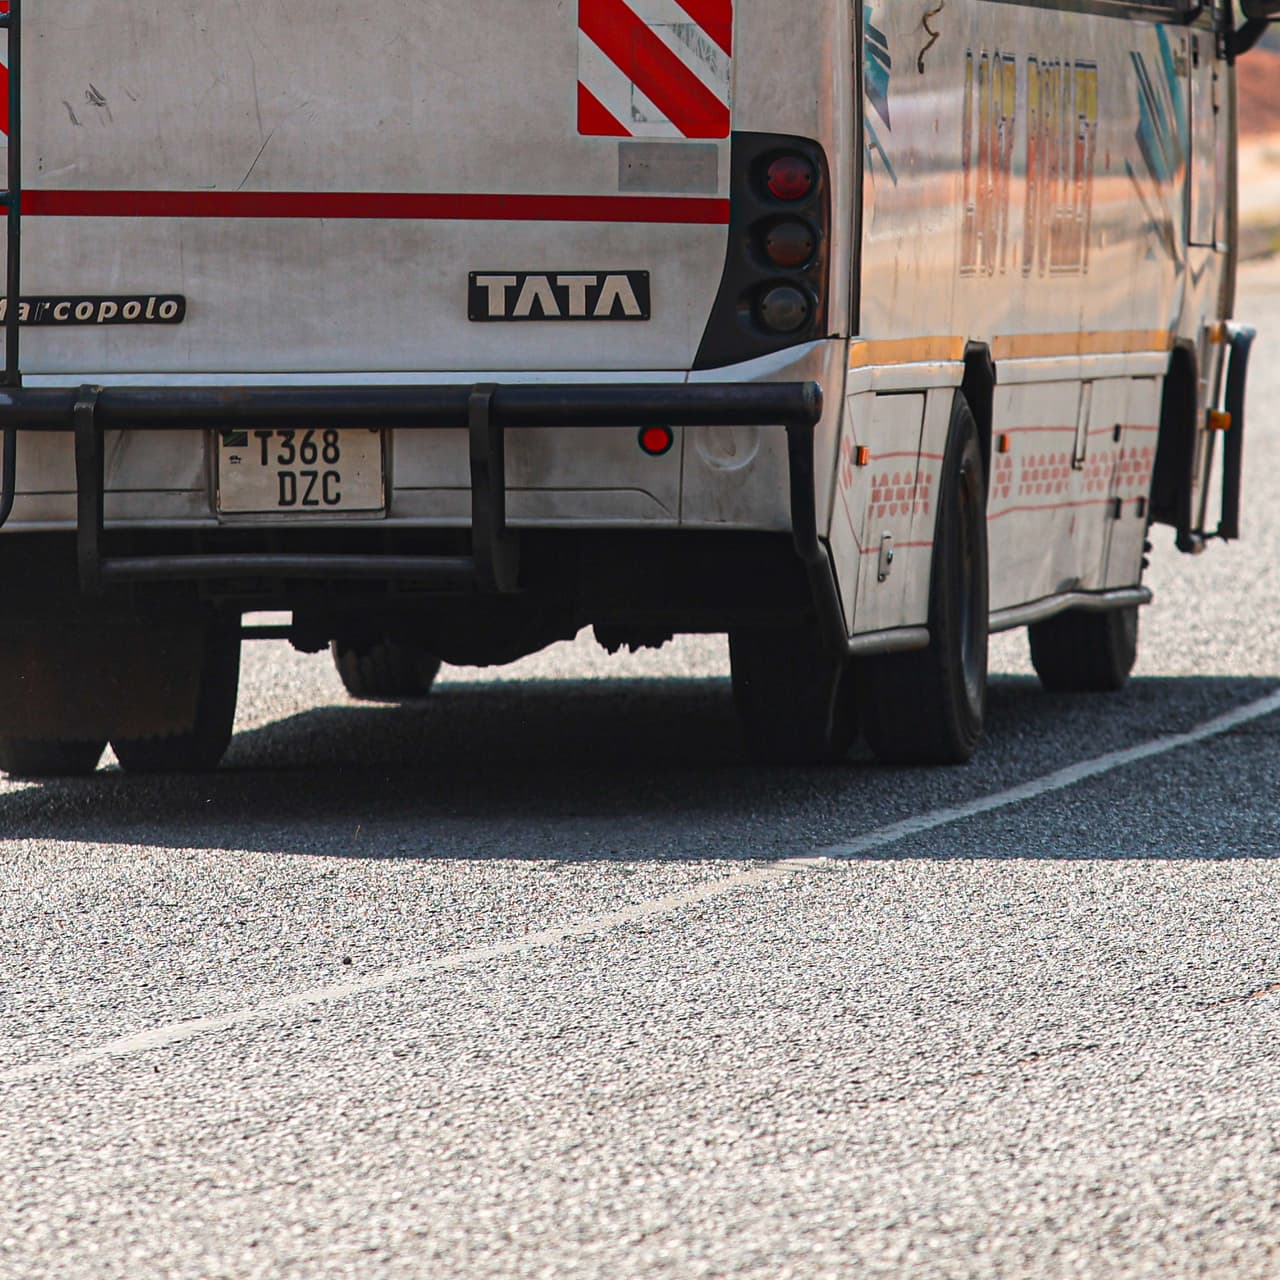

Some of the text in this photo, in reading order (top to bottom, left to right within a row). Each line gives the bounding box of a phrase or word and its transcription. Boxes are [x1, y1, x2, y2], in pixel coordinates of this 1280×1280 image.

[476, 275, 642, 317] TATA
[254, 429, 340, 466] T368
[277, 471, 341, 506] DZC
